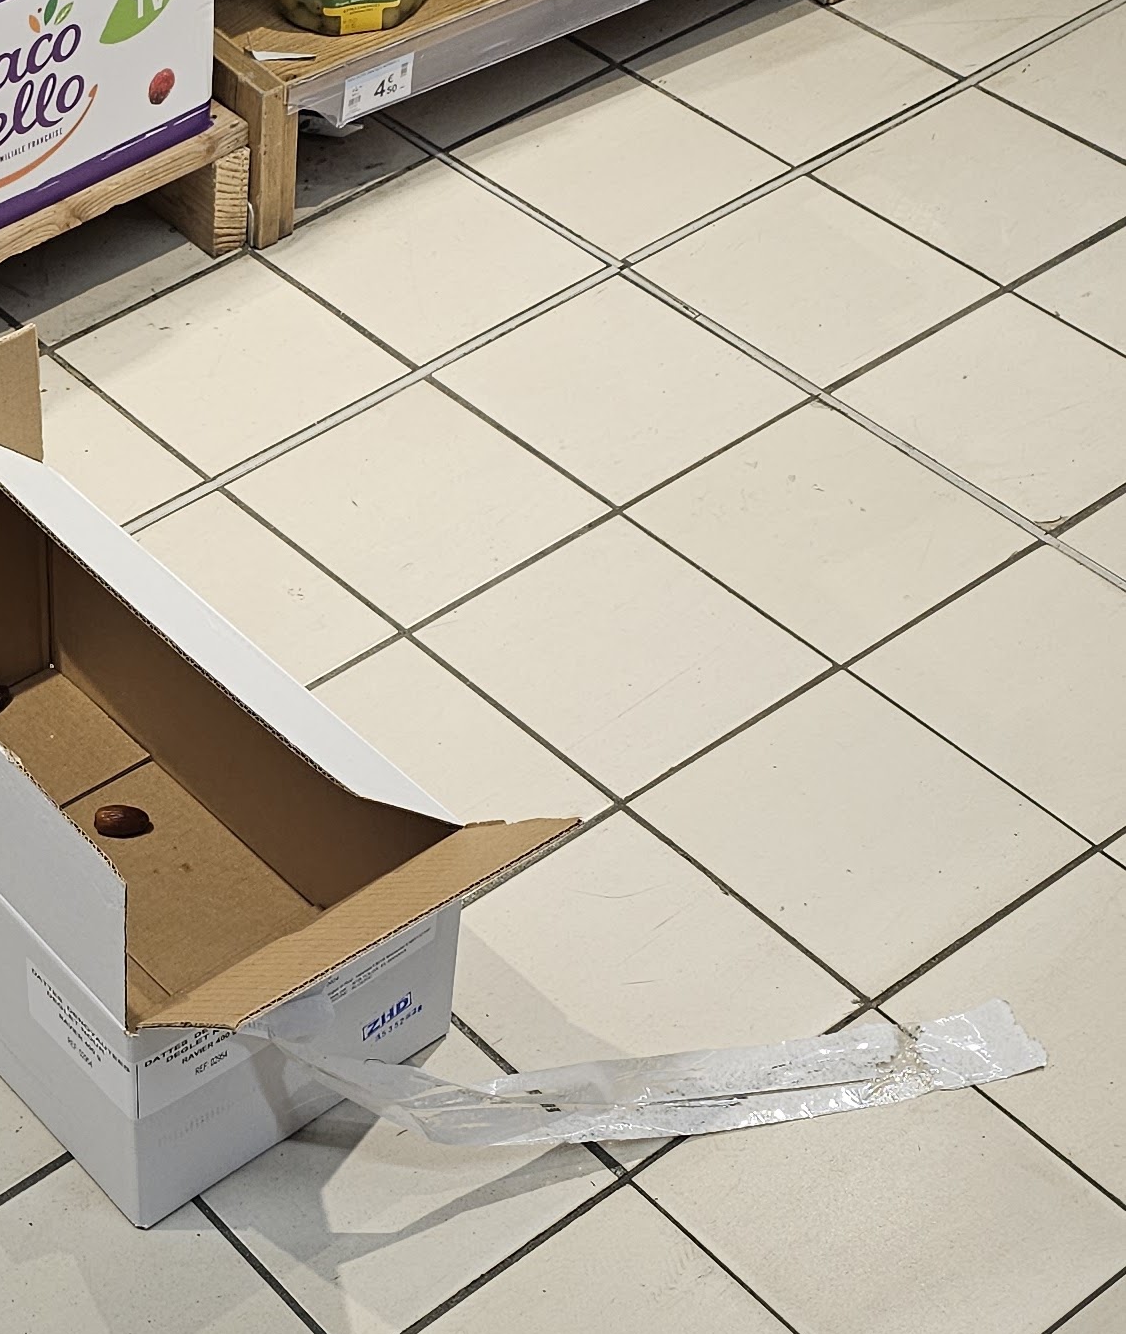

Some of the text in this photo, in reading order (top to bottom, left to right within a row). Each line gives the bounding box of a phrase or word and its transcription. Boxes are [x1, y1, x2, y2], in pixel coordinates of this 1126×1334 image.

[366, 993, 411, 1038] ZHD
[145, 1039, 188, 1067] DATTES
[166, 1033, 208, 1063] DEGLET
[181, 1032, 231, 1064] RAVIER 400
